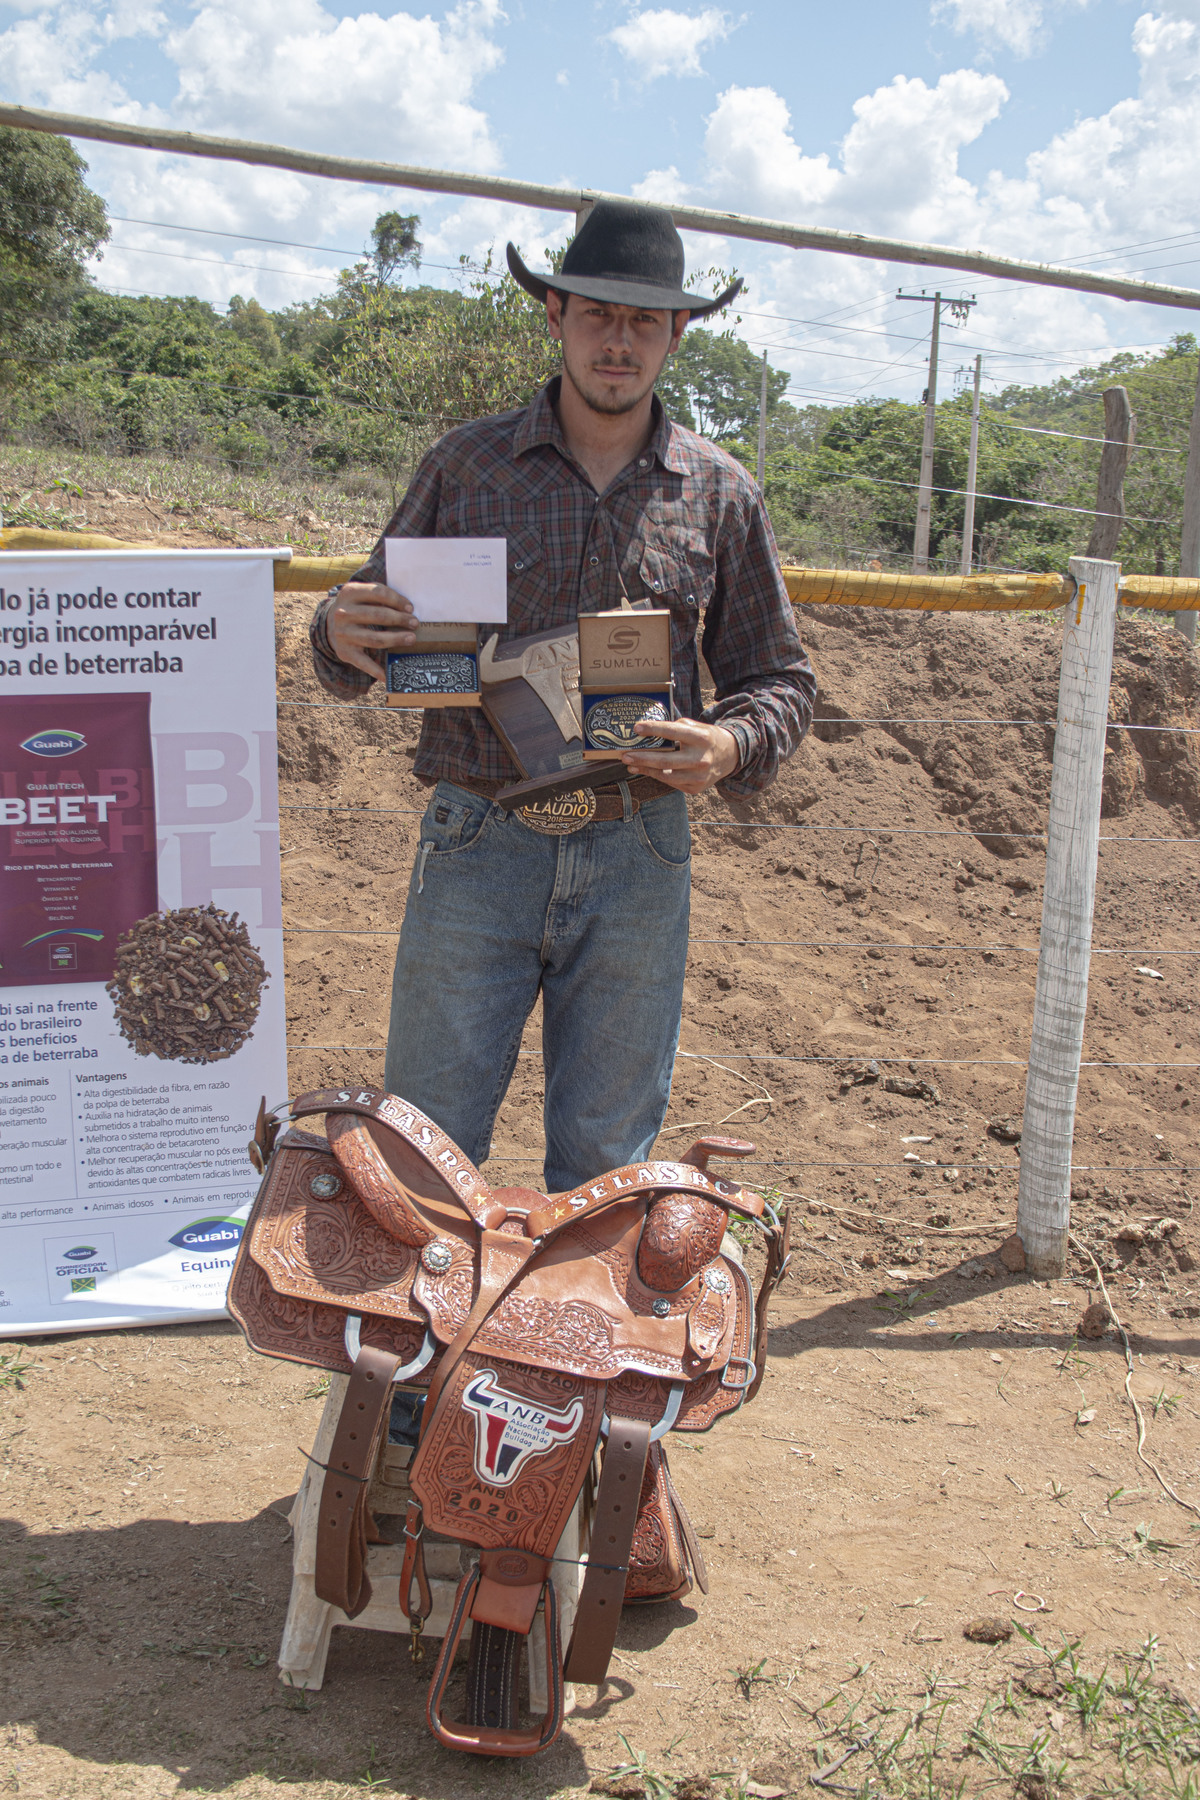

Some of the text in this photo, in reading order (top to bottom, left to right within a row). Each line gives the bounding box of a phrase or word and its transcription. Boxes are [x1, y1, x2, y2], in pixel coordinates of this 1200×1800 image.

[27, 587, 50, 616] já
[57, 586, 118, 616] pode
[124, 588, 202, 608] contar
[0, 617, 217, 649] rgia incomparável
[29, 653, 58, 675] de
[65, 651, 184, 675] beterraba
[589, 657, 660, 669] SUMETAL
[33, 740, 73, 749] Guabi
[0, 795, 117, 825] BEET
[15, 1002, 33, 1014] sai
[37, 1003, 54, 1013] na
[57, 1000, 98, 1012] frente
[0, 1016, 82, 1031] do brasileiro
[9, 1032, 77, 1047] benefícios
[12, 1051, 29, 1063] de
[33, 1046, 98, 1062] beterraba
[11, 1077, 50, 1088] animais
[75, 1072, 128, 1083] Vantagens
[84, 1081, 230, 1098] Alta digestibilidade da fibra, em razão
[30, 1094, 57, 1104] pouco
[83, 1096, 169, 1110] da polpa de beterraba
[9, 1105, 45, 1117] digestão
[85, 1103, 213, 1121] Auxilia na hidratação de animais
[84, 1114, 229, 1133] submetidos a trabalho muito intenso
[86, 1133, 119, 1144] Melhora
[121, 1133, 127, 1141] o
[129, 1131, 158, 1140] sistema
[160, 1127, 204, 1139] reprodutivo
[205, 1126, 218, 1134] em
[220, 1123, 247, 1134] função
[333, 1091, 475, 1187] SELAS RC
[31, 1137, 67, 1148] muscular
[86, 1137, 220, 1155] alta concentração de betacaroteno
[87, 1156, 116, 1166] Melhor
[118, 1152, 166, 1164] recuperação
[167, 1149, 202, 1160] muscular
[204, 1149, 214, 1157] no
[216, 1147, 230, 1157] pós
[20, 1163, 34, 1172] um
[36, 1161, 55, 1170] todo
[87, 1167, 114, 1177] devido
[115, 1167, 124, 1175] às
[126, 1165, 144, 1174] altas
[146, 1160, 201, 1173] concentrações
[88, 1167, 251, 1189] antioxidantes que combatem radicais livres
[568, 1165, 731, 1212] SELAS RC
[92, 1199, 154, 1211] Animais idosos
[172, 1194, 205, 1205] Animais
[207, 1193, 221, 1202] em
[1, 1206, 74, 1220] alta performance
[182, 1228, 239, 1244] Guabi
[56, 1265, 109, 1277] OFICIAL
[493, 1400, 547, 1425] ANB
[507, 1424, 549, 1445] Nacional de
[510, 1418, 551, 1437] Associação
[504, 1431, 533, 1448] Bulldog
[471, 1481, 507, 1500] ANB
[450, 1491, 519, 1523] 2020
